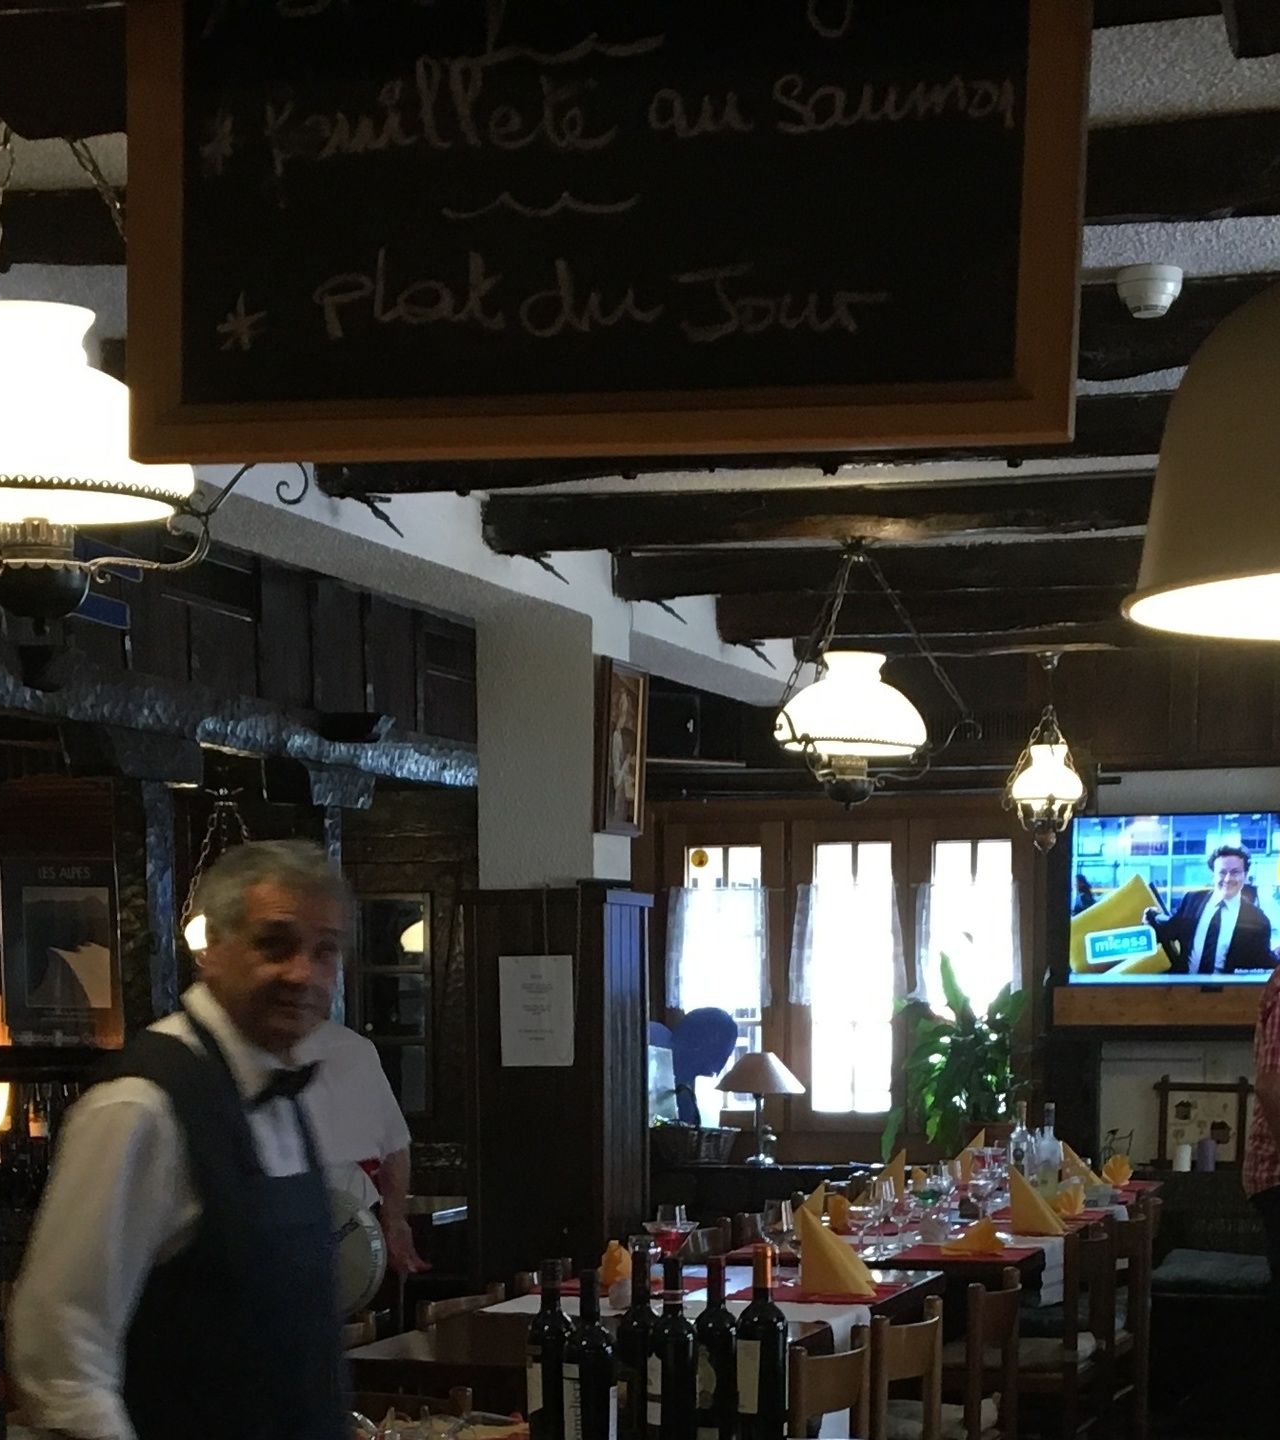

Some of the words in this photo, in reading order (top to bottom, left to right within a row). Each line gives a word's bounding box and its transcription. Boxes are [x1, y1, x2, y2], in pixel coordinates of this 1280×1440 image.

[647, 88, 754, 139] au
[520, 259, 662, 339] du
[1094, 935, 1148, 953] micasa
